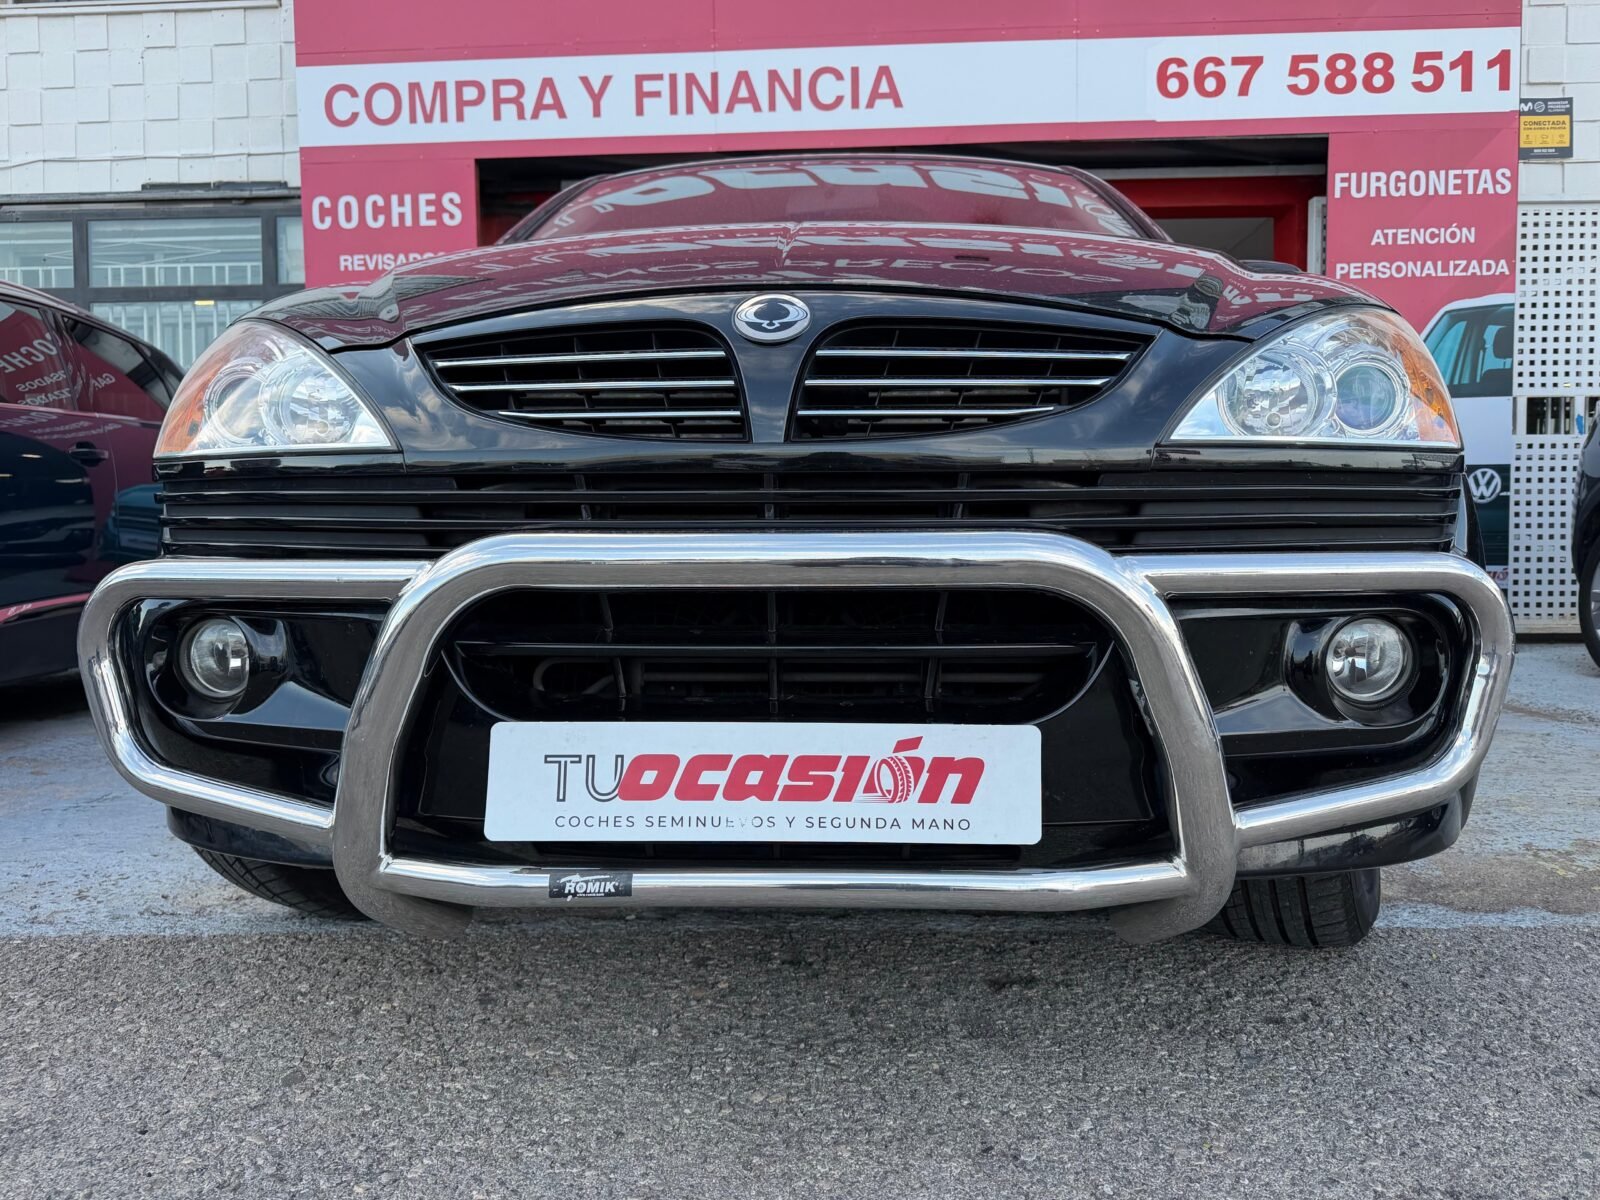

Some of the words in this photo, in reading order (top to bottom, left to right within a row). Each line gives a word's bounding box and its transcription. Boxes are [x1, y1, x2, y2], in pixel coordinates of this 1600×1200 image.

[1156, 56, 1264, 99] 667
[1286, 52, 1395, 96] 588
[1411, 49, 1511, 93] 511
[324, 77, 567, 128] COMPRA
[580, 75, 613, 118] Y
[634, 65, 904, 117] FINANCIA
[1333, 167, 1512, 199] FURGONETAS
[312, 191, 463, 230] COCHES
[1370, 223, 1476, 246] ATENCIÓN
[339, 251, 446, 271] REVISAD
[1335, 259, 1510, 280] PERSONALIZADA
[554, 815, 635, 828] COCHES
[785, 816, 797, 829] Y
[805, 816, 902, 830] SEGUNDA
[911, 818, 971, 831] MANO
[564, 881, 616, 894] ROMIK
